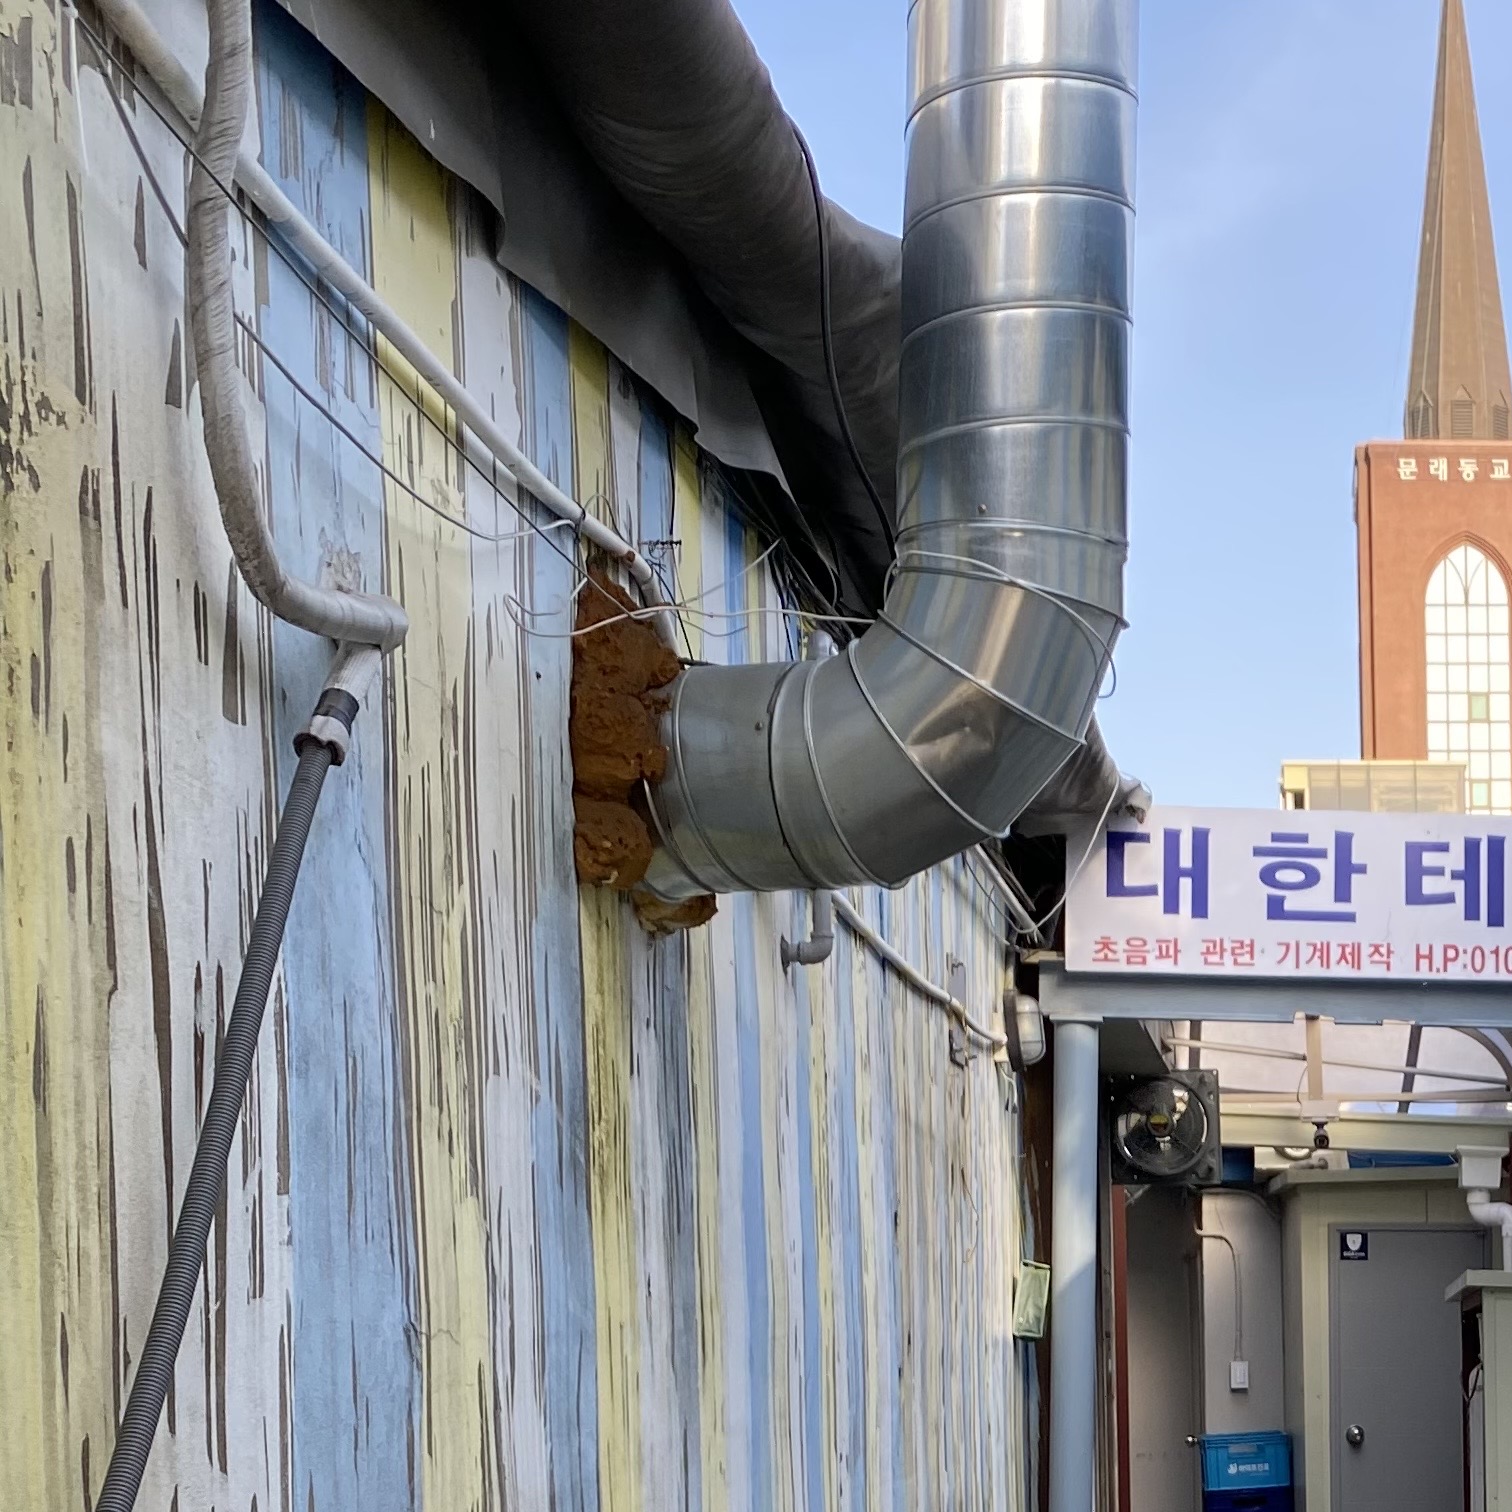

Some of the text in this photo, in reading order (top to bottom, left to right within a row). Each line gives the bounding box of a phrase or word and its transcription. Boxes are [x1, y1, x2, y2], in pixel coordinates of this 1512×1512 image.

[1091, 936, 1182, 967] 초음파
[1200, 937, 1256, 967] 관련
[1276, 940, 1395, 971] 기계제작
